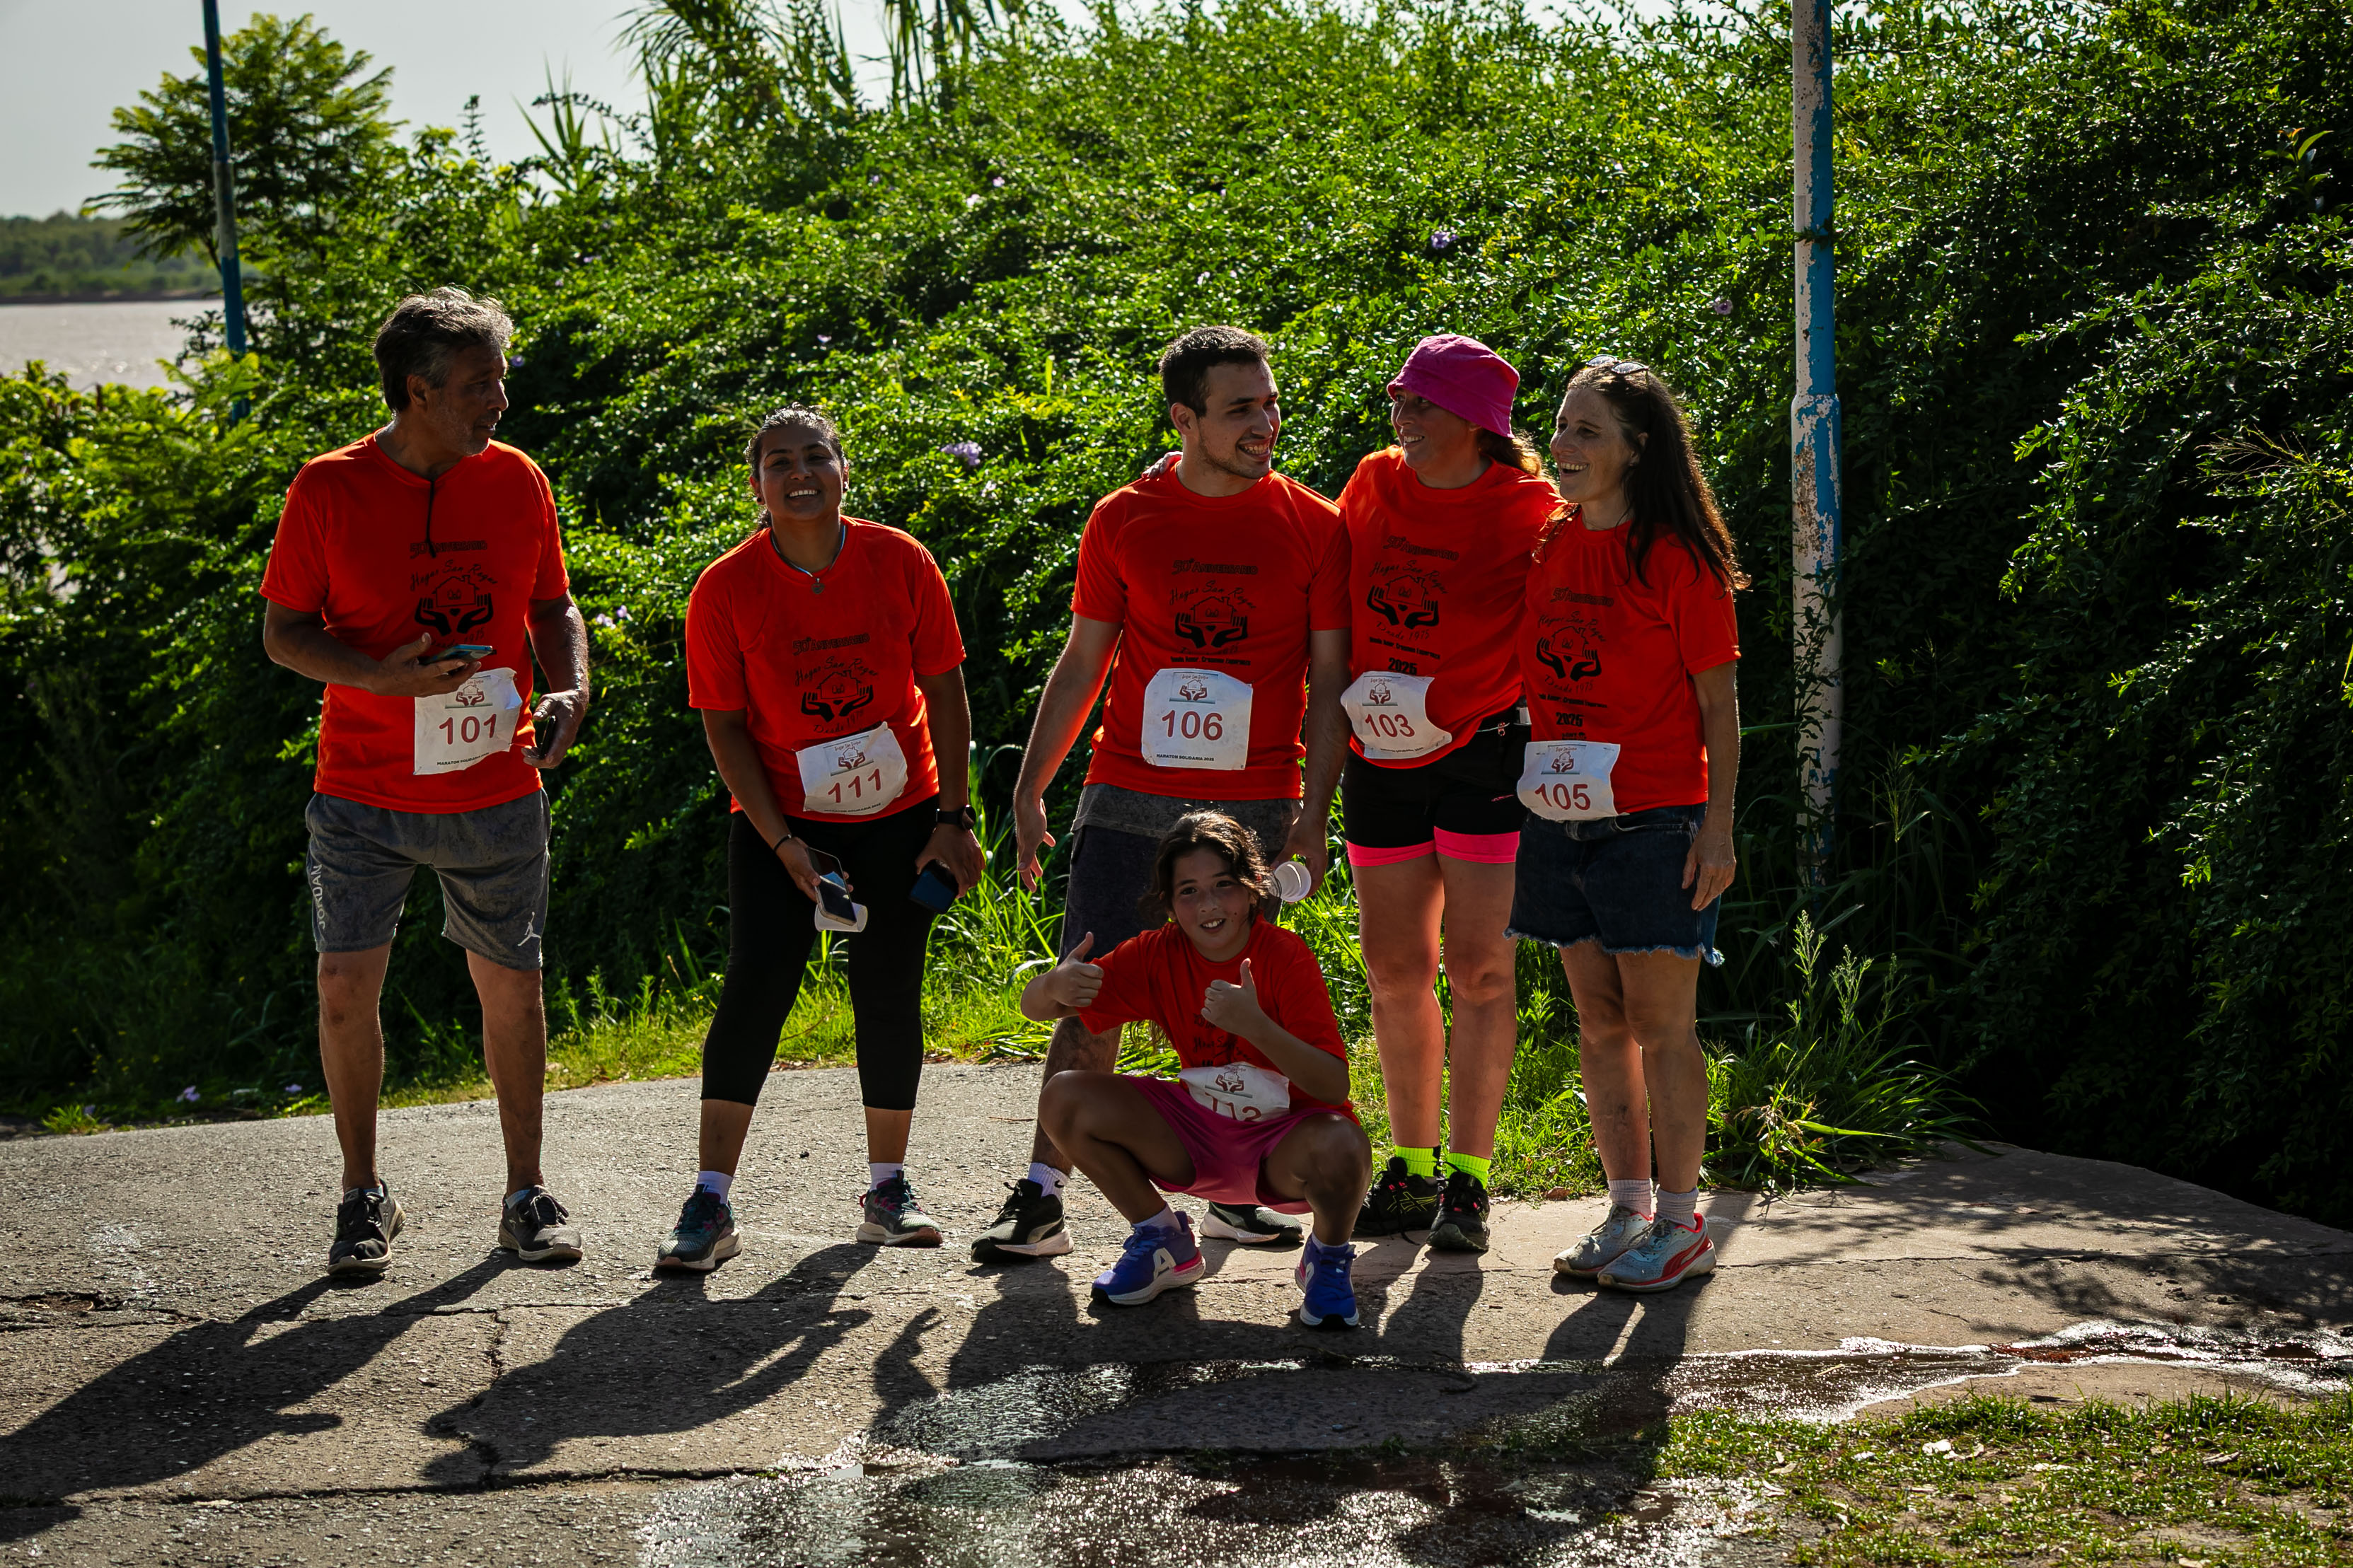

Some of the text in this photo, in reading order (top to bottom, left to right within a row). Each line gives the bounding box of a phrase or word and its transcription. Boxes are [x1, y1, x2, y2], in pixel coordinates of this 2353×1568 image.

[1202, 580, 1225, 593] San
[823, 656, 845, 670] San
[1387, 657, 1418, 675] 2025
[439, 714, 497, 745] 101
[1162, 709, 1223, 741] 106
[1365, 714, 1415, 738] 103
[1556, 712, 1585, 727] 2025
[828, 768, 881, 803] 111
[1534, 783, 1591, 811] 105
[311, 864, 325, 930] JORDAN
